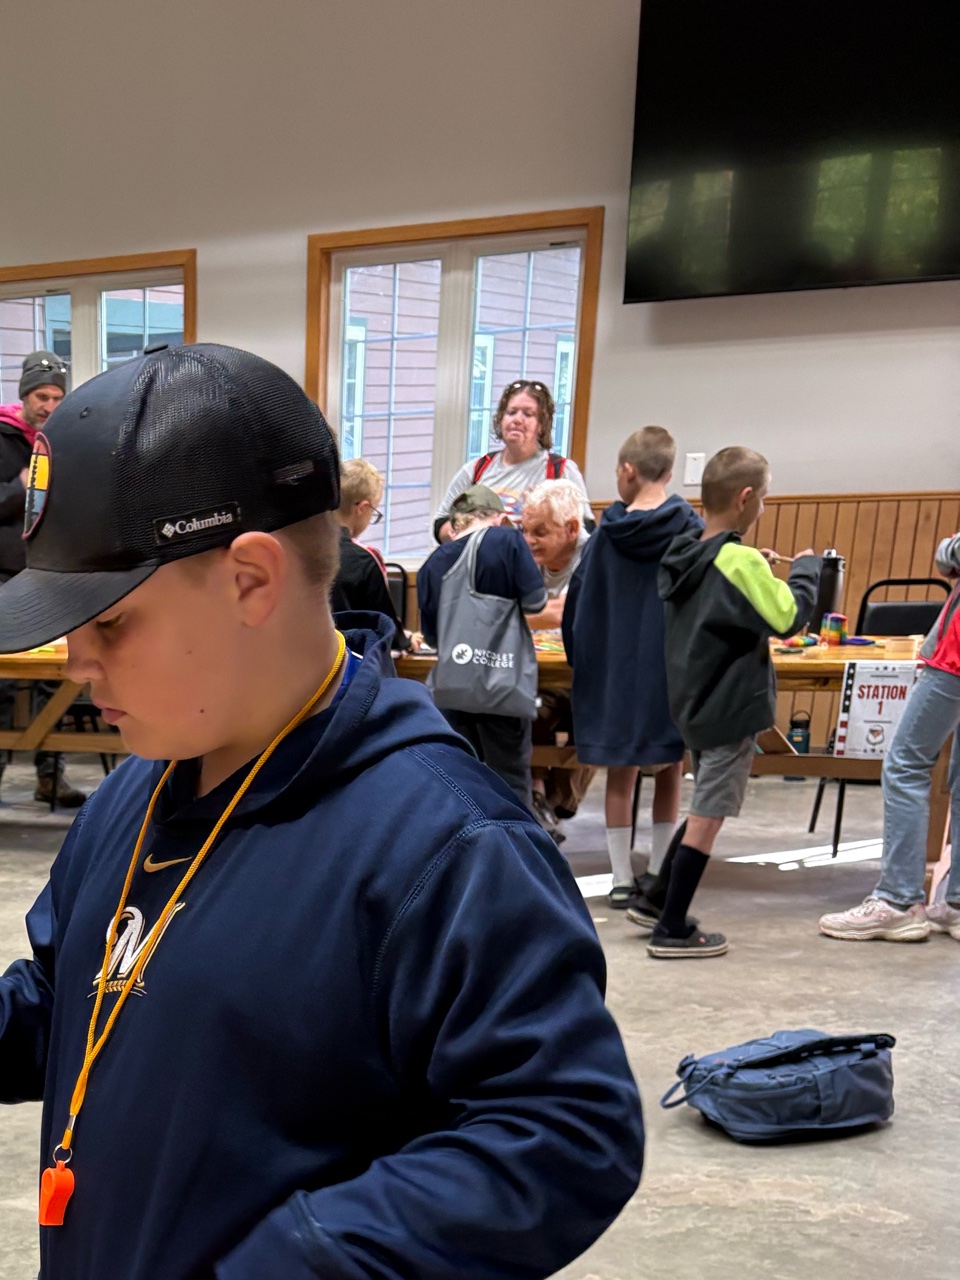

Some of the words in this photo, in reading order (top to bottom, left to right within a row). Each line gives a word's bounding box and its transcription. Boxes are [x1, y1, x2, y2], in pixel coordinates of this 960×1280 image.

[175, 511, 233, 534] Columbia
[473, 648, 514, 661] NICOLET
[472, 656, 515, 668] COLLEGE
[857, 684, 908, 700] STATION
[877, 701, 883, 715] 1
